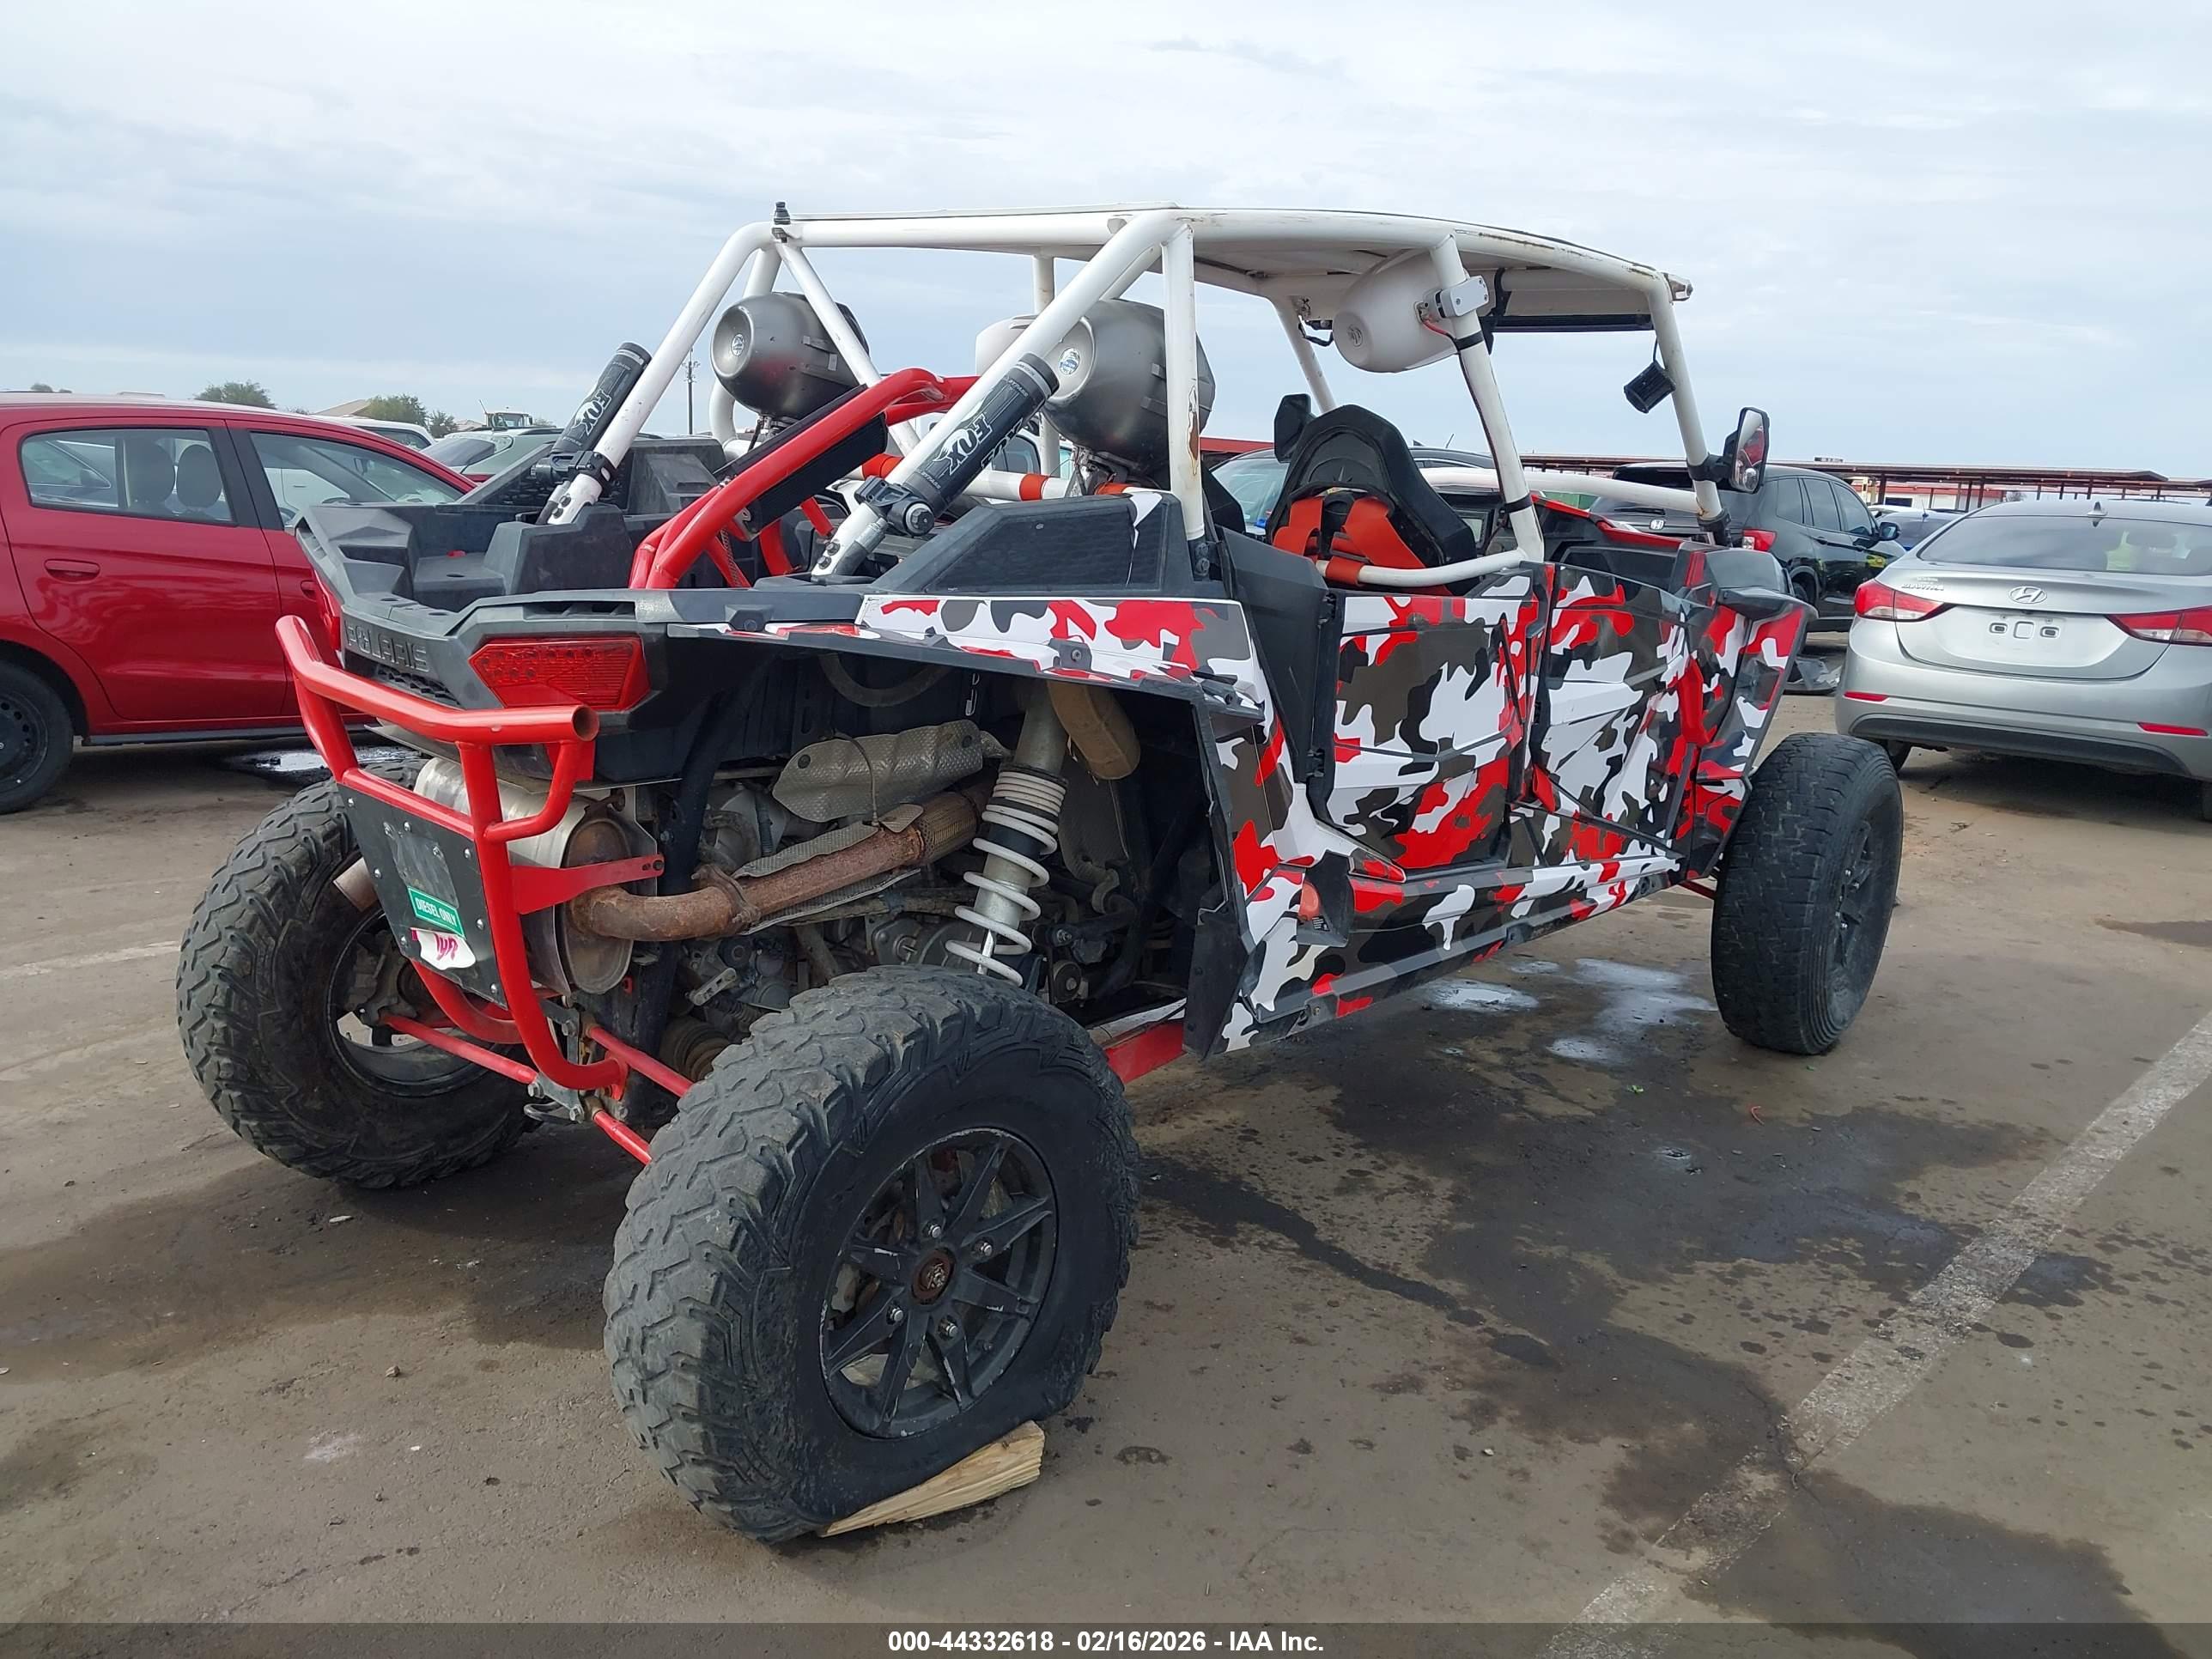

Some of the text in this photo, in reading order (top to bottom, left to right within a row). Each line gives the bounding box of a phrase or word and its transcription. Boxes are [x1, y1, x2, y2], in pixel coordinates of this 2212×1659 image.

[580, 388, 612, 436] FOX
[946, 412, 993, 476] FOX
[343, 619, 429, 672] POLARIS
[415, 896, 458, 927] DIESEL ONLY
